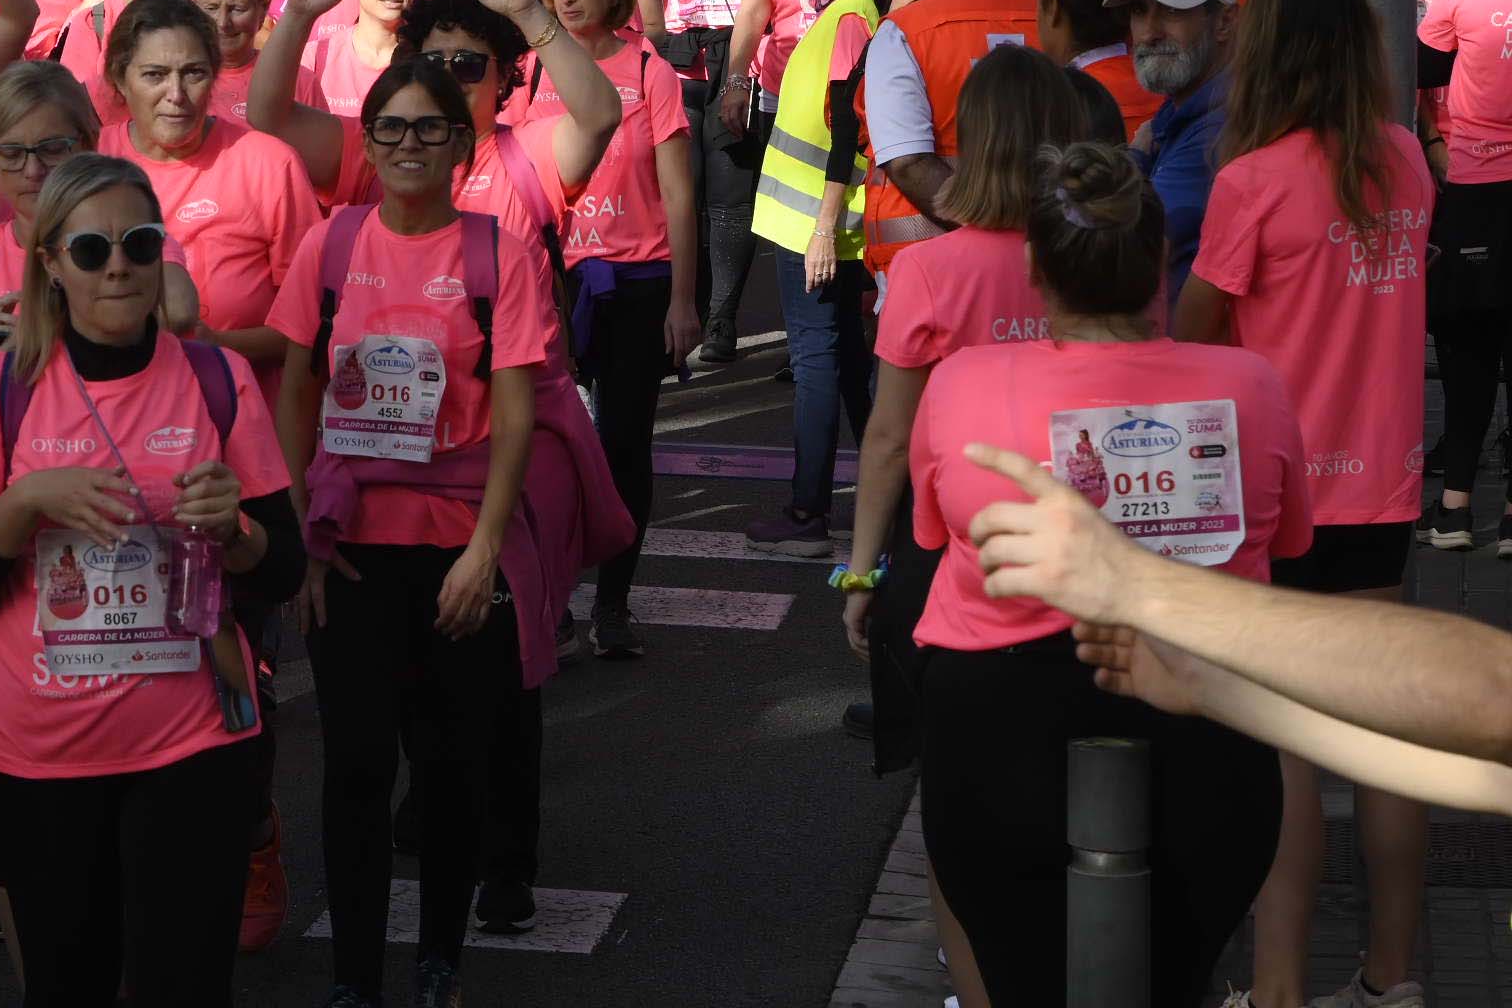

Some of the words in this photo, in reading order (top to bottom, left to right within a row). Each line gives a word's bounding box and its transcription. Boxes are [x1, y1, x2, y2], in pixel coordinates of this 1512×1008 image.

[1351, 239, 1380, 264] DE
[1387, 235, 1414, 258] LA
[1346, 256, 1418, 287] MUJER
[368, 355, 412, 369] ASTURIANA
[371, 384, 410, 403] 016
[378, 407, 403, 419] 4552
[339, 420, 375, 431] CARRERA
[377, 423, 388, 431] DE
[398, 424, 419, 433] MUJER
[1187, 423, 1223, 434] SUMA
[31, 438, 96, 455] OYSHO
[334, 435, 376, 449] OYSHO
[1108, 437, 1175, 451] ASTURIANA
[1114, 470, 1176, 495] 016
[1121, 501, 1170, 517] 27213
[1127, 525, 1142, 534] DE
[1144, 524, 1158, 533] LA
[1160, 522, 1196, 532] MUJER
[1201, 520, 1225, 529] 2023
[91, 549, 150, 564] ASTURIANA
[1174, 543, 1231, 556] Santander
[94, 584, 148, 606] 016
[104, 612, 138, 625] 8067
[58, 632, 103, 642] CARRERA
[105, 632, 118, 641] DE
[119, 631, 132, 641] LA
[135, 630, 165, 640] MUJER
[54, 653, 104, 666] OYSHO
